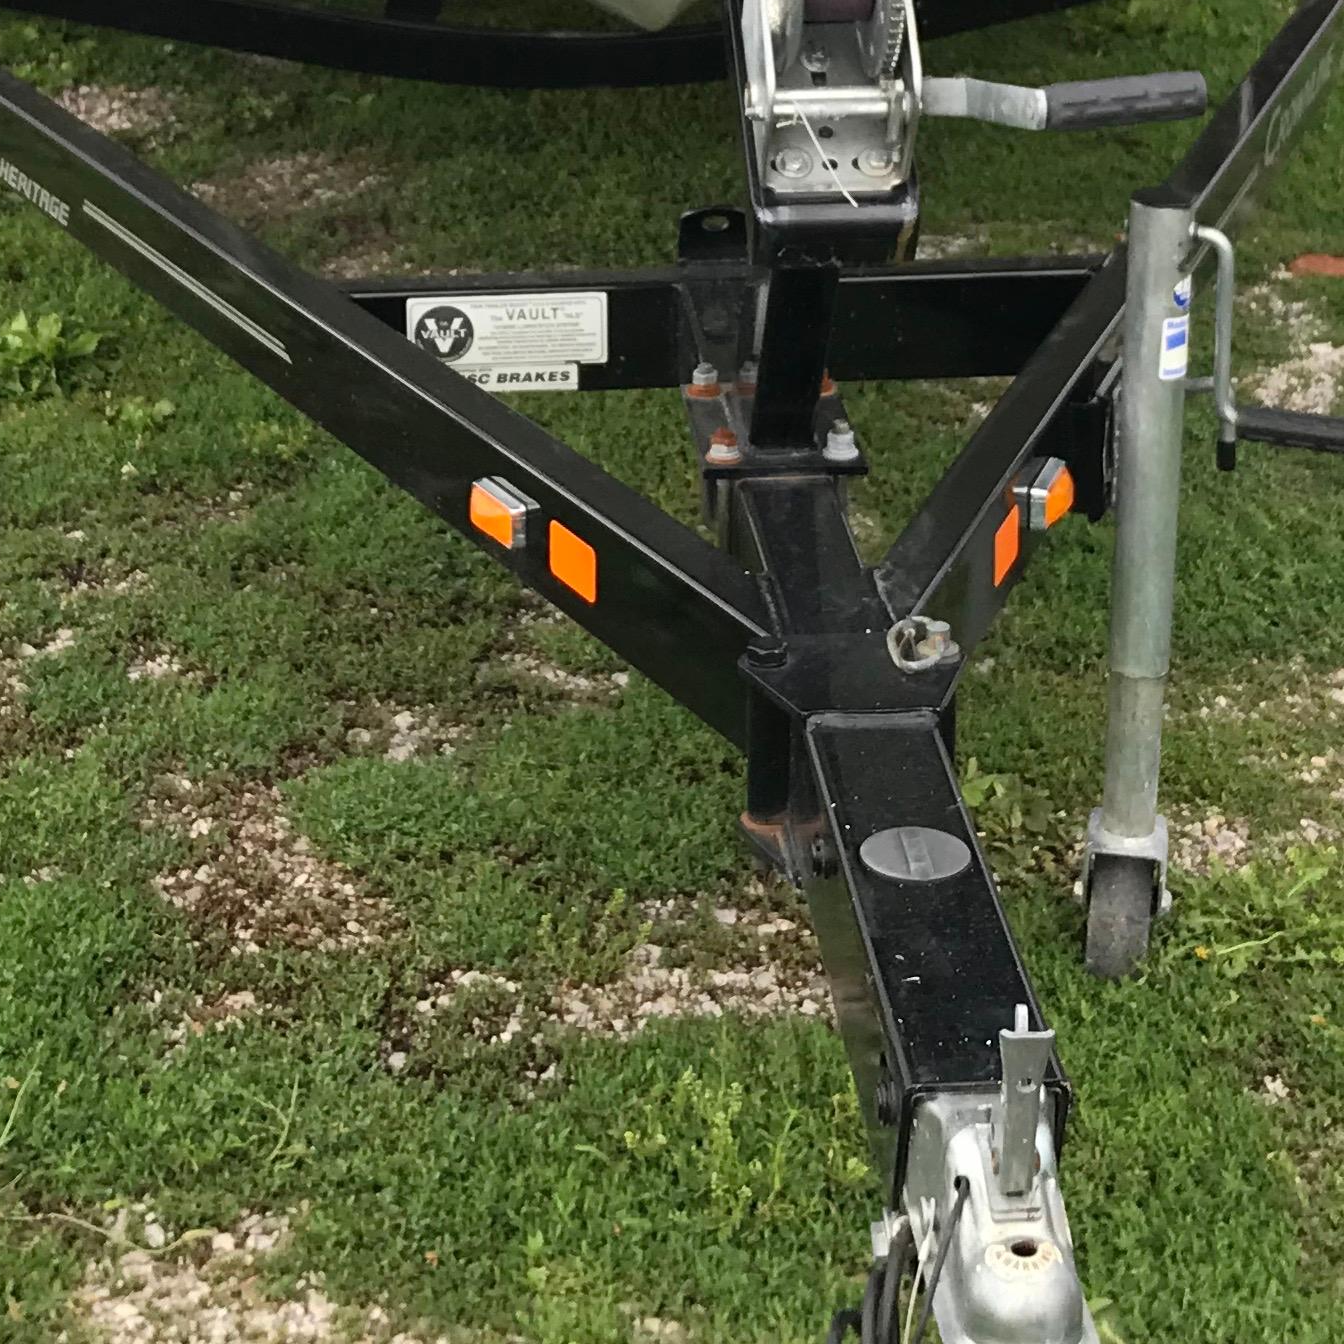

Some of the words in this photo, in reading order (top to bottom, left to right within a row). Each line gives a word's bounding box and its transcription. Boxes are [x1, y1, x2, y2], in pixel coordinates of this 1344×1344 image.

[505, 307, 560, 321] VAULT
[420, 328, 467, 339] VAULT
[496, 371, 571, 384] BRAKES
